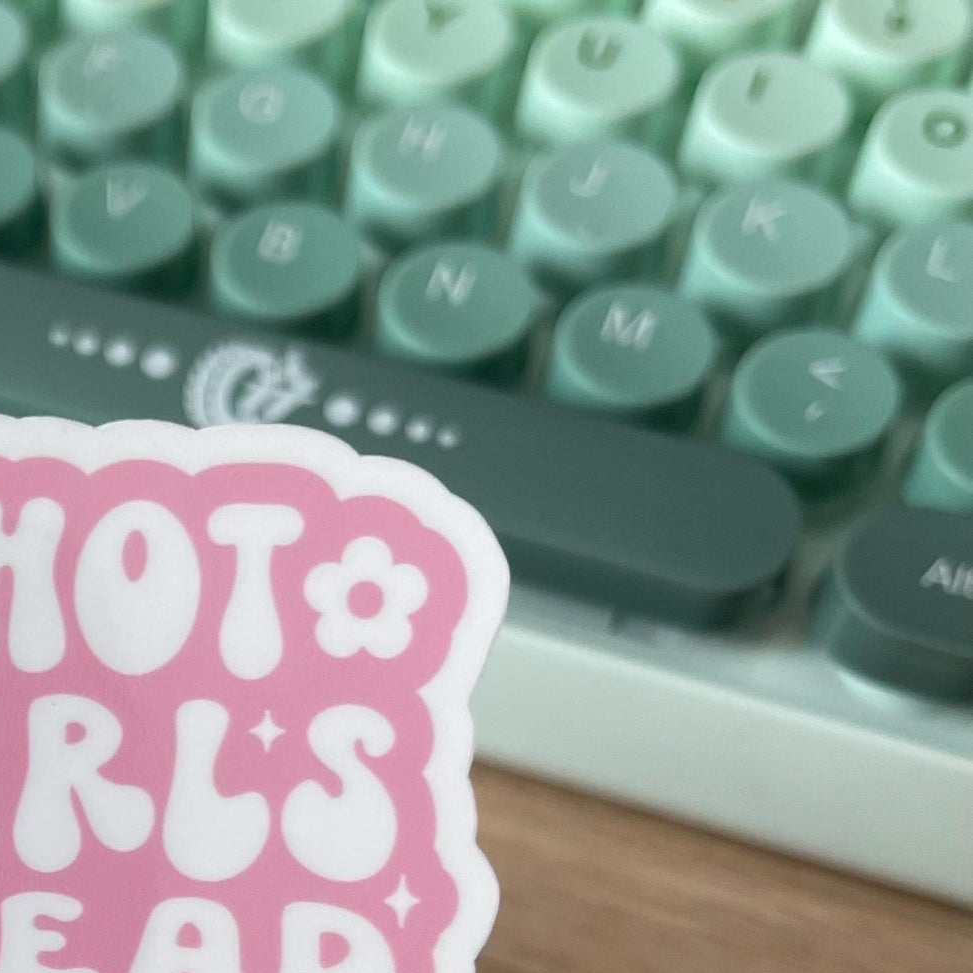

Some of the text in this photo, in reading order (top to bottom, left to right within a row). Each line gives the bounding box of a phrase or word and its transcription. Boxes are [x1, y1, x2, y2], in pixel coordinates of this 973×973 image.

[576, 26, 623, 72] U
[238, 82, 287, 125] G
[747, 67, 770, 104] I
[397, 117, 449, 161] H
[920, 107, 969, 149] O
[106, 177, 153, 218] V
[568, 156, 608, 198] J
[741, 194, 788, 241] K
[255, 220, 303, 265] B
[927, 235, 964, 283] L
[428, 258, 478, 305] N
[600, 301, 659, 352] M
